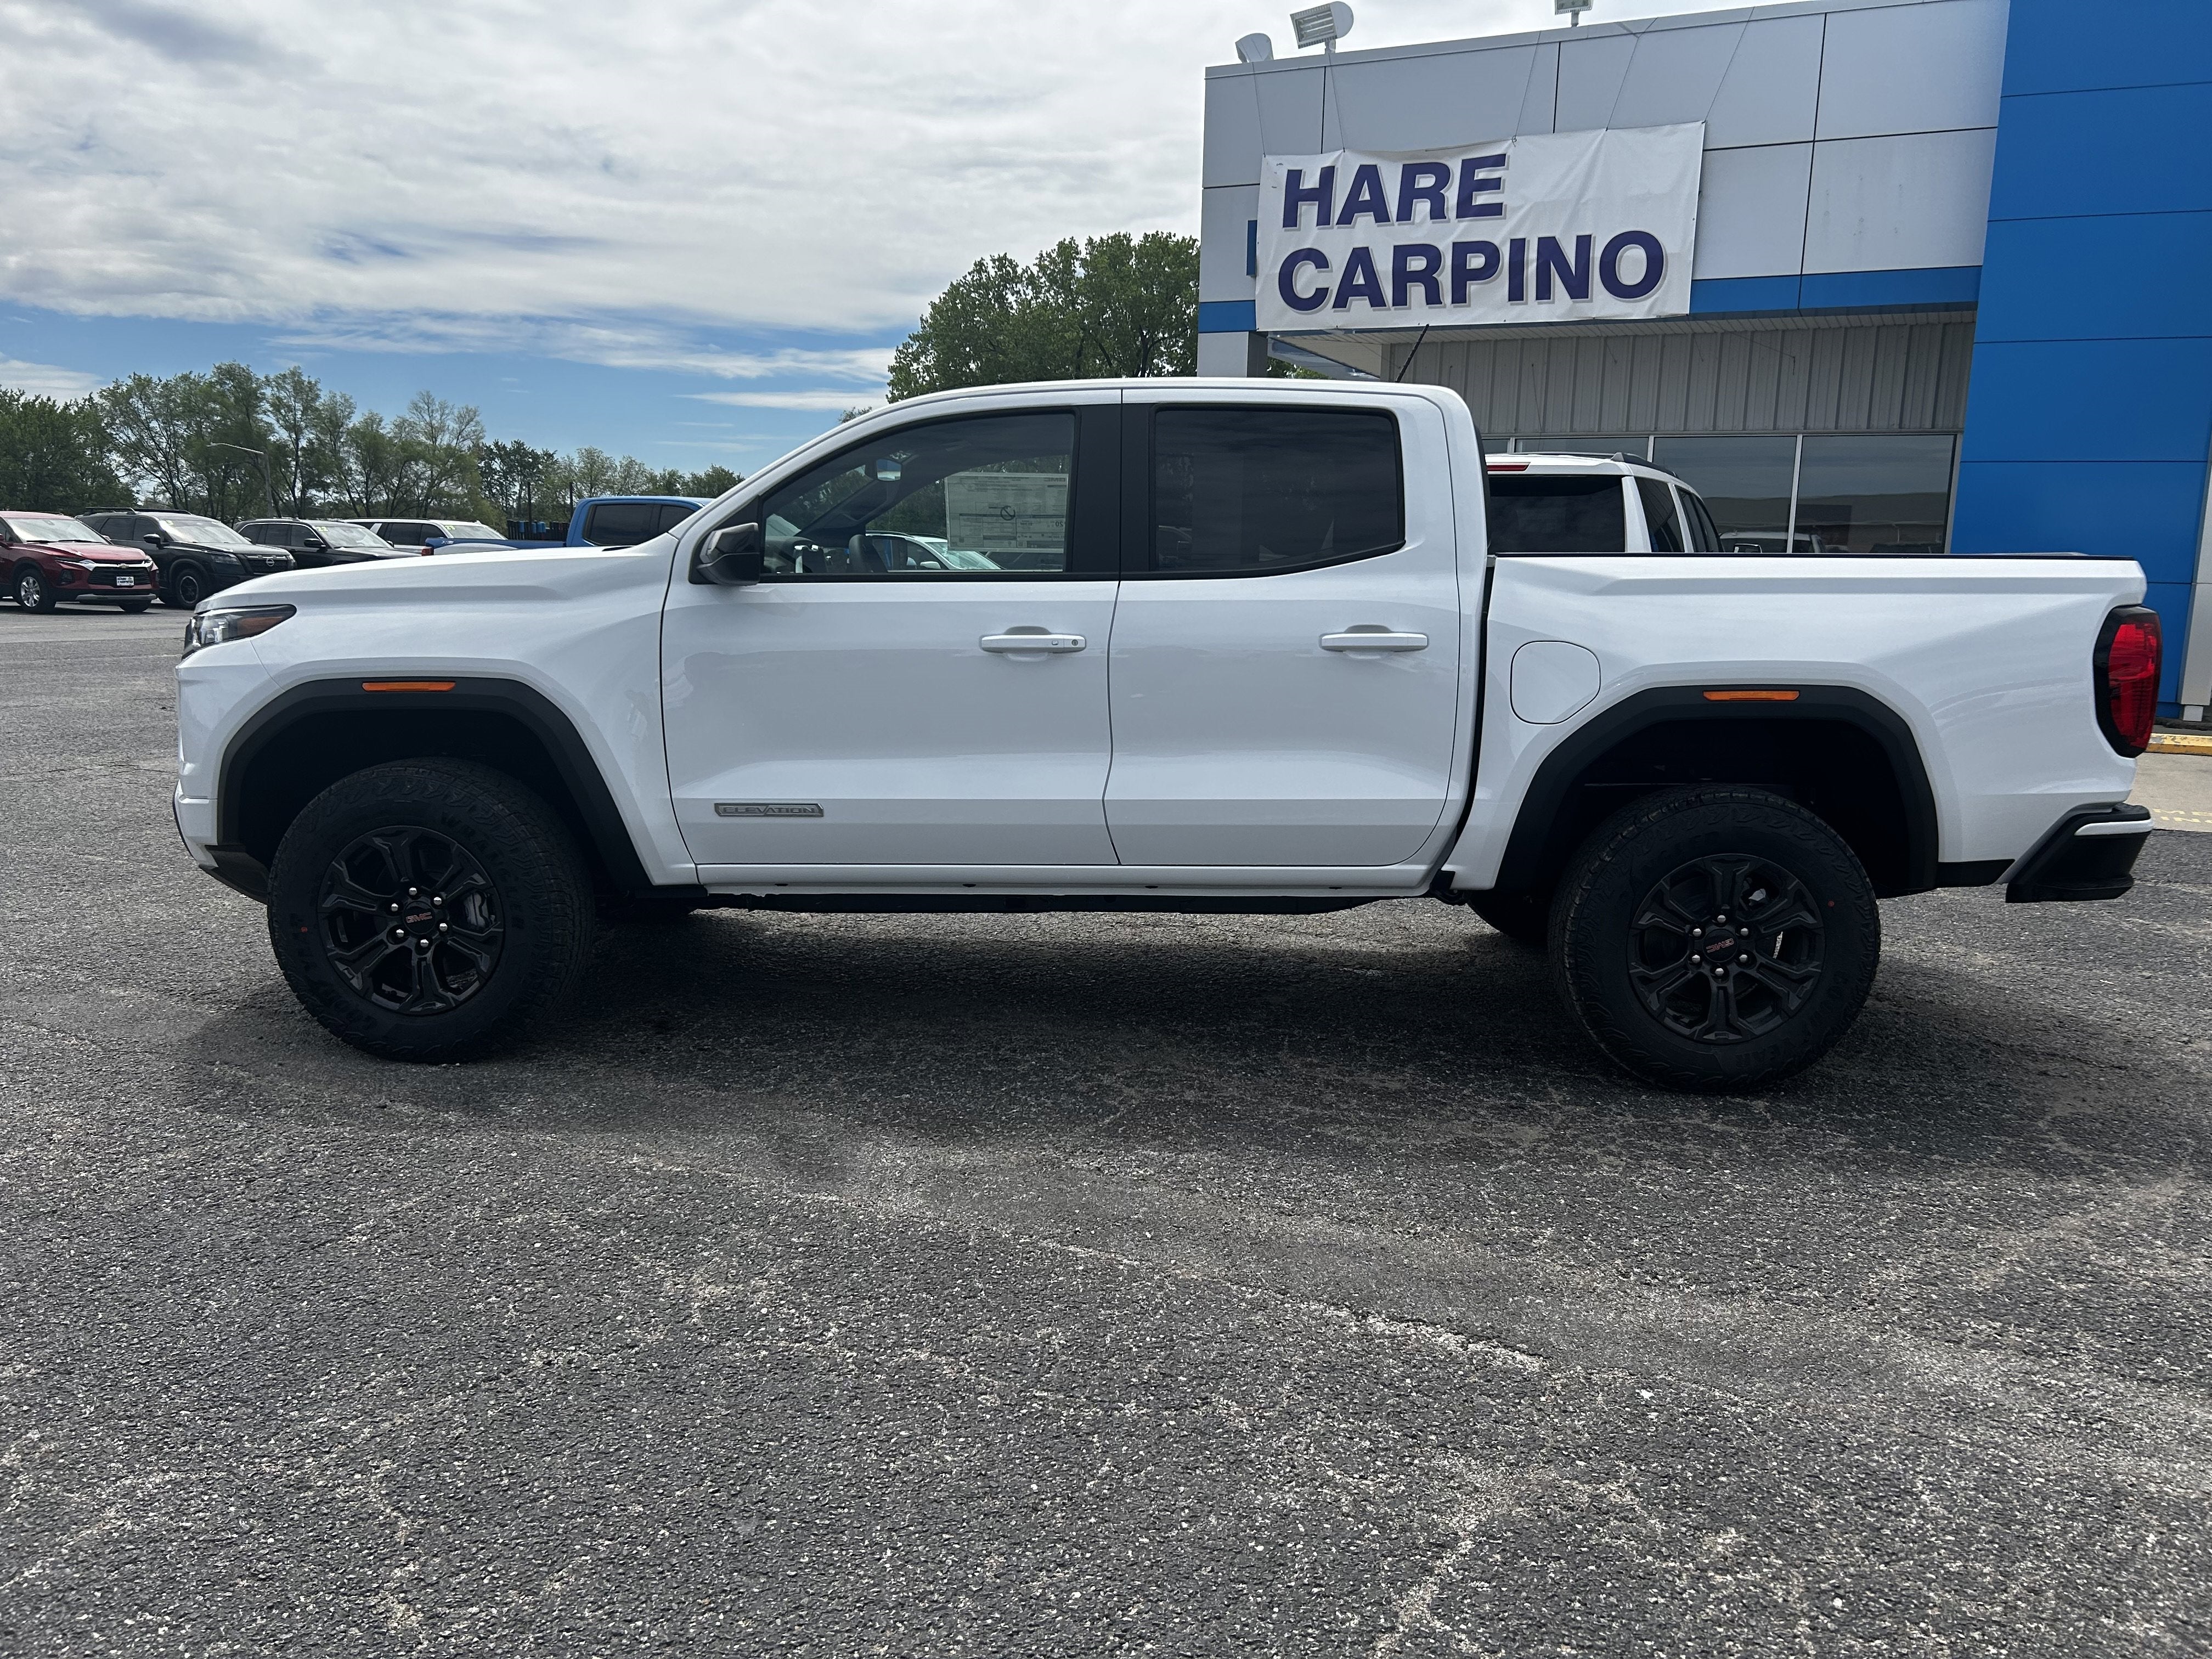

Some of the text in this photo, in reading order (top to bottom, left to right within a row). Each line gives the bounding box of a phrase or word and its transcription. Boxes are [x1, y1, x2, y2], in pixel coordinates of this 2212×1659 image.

[1282, 154, 1506, 228] HARE
[1278, 231, 1664, 312] CARPINO
[405, 912, 433, 923] GMC
[1706, 938, 1734, 953] GMC
